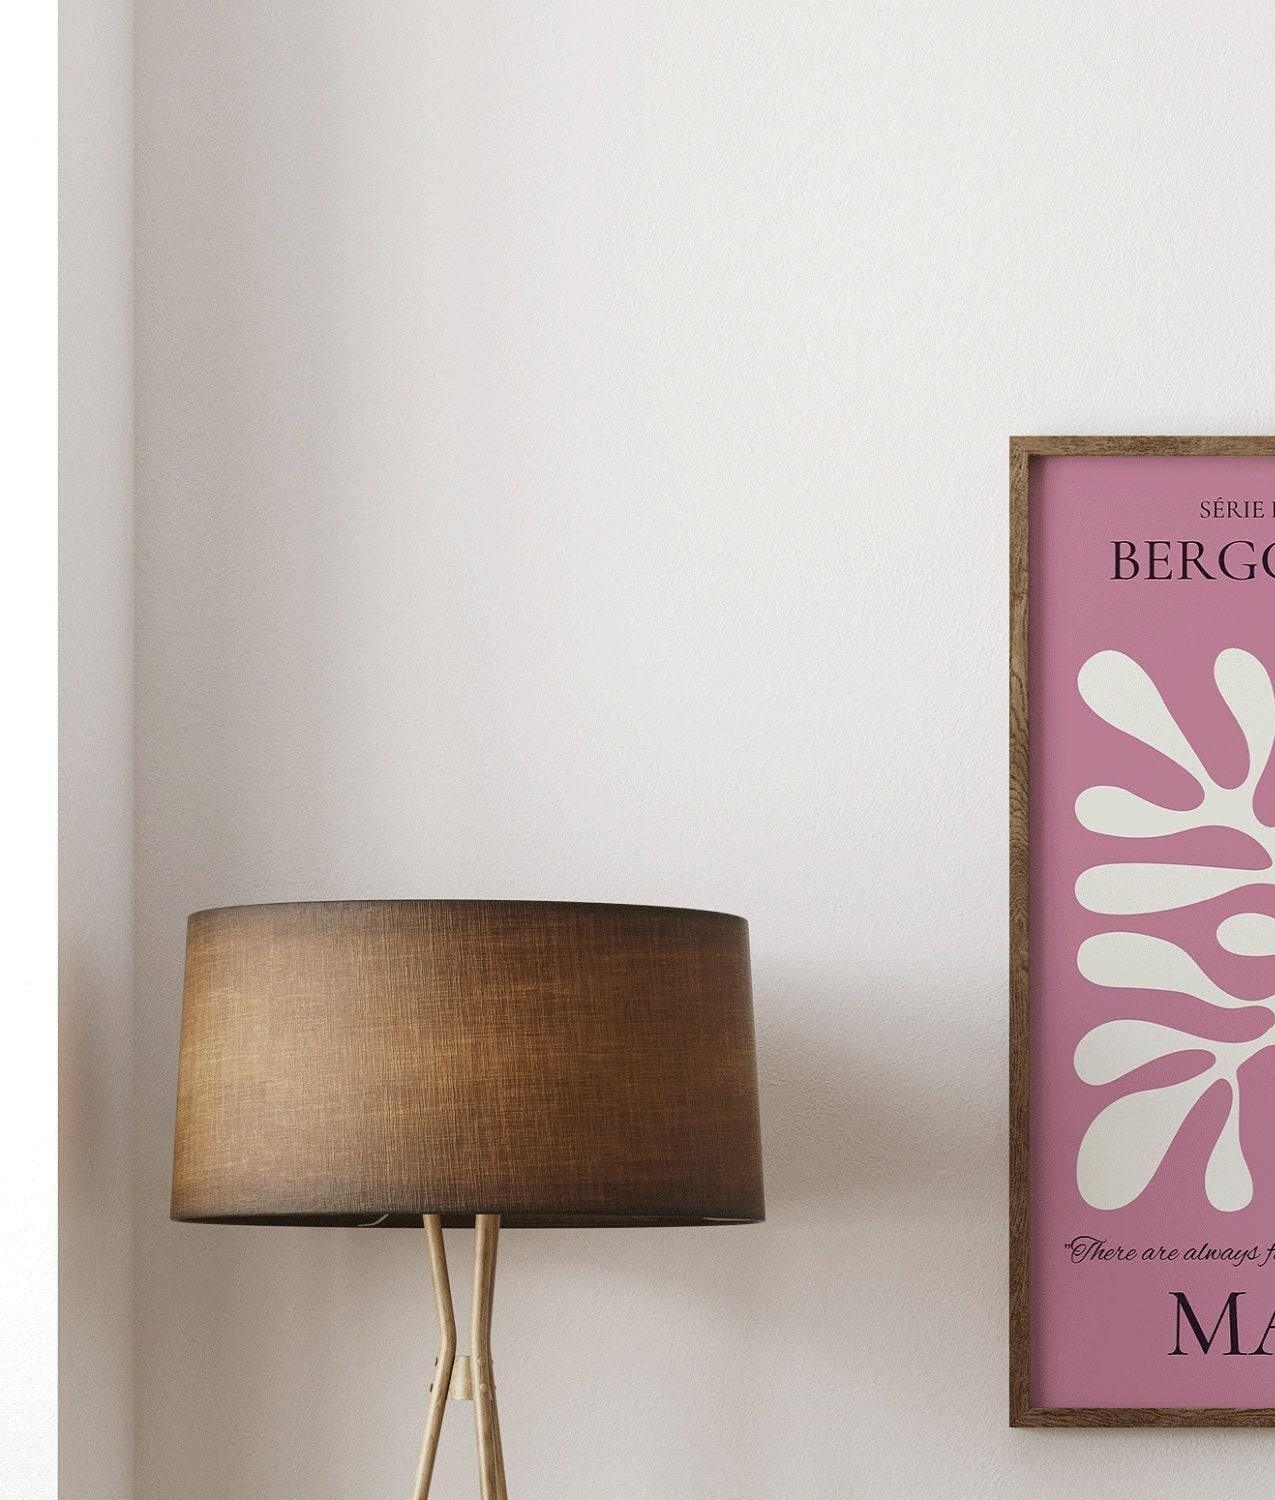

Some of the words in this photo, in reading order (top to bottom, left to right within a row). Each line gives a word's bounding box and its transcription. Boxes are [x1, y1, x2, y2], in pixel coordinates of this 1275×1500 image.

[1199, 497, 1265, 519] SÉRIE
[1141, 1245, 1179, 1261] are
[1183, 1242, 1261, 1267] always
